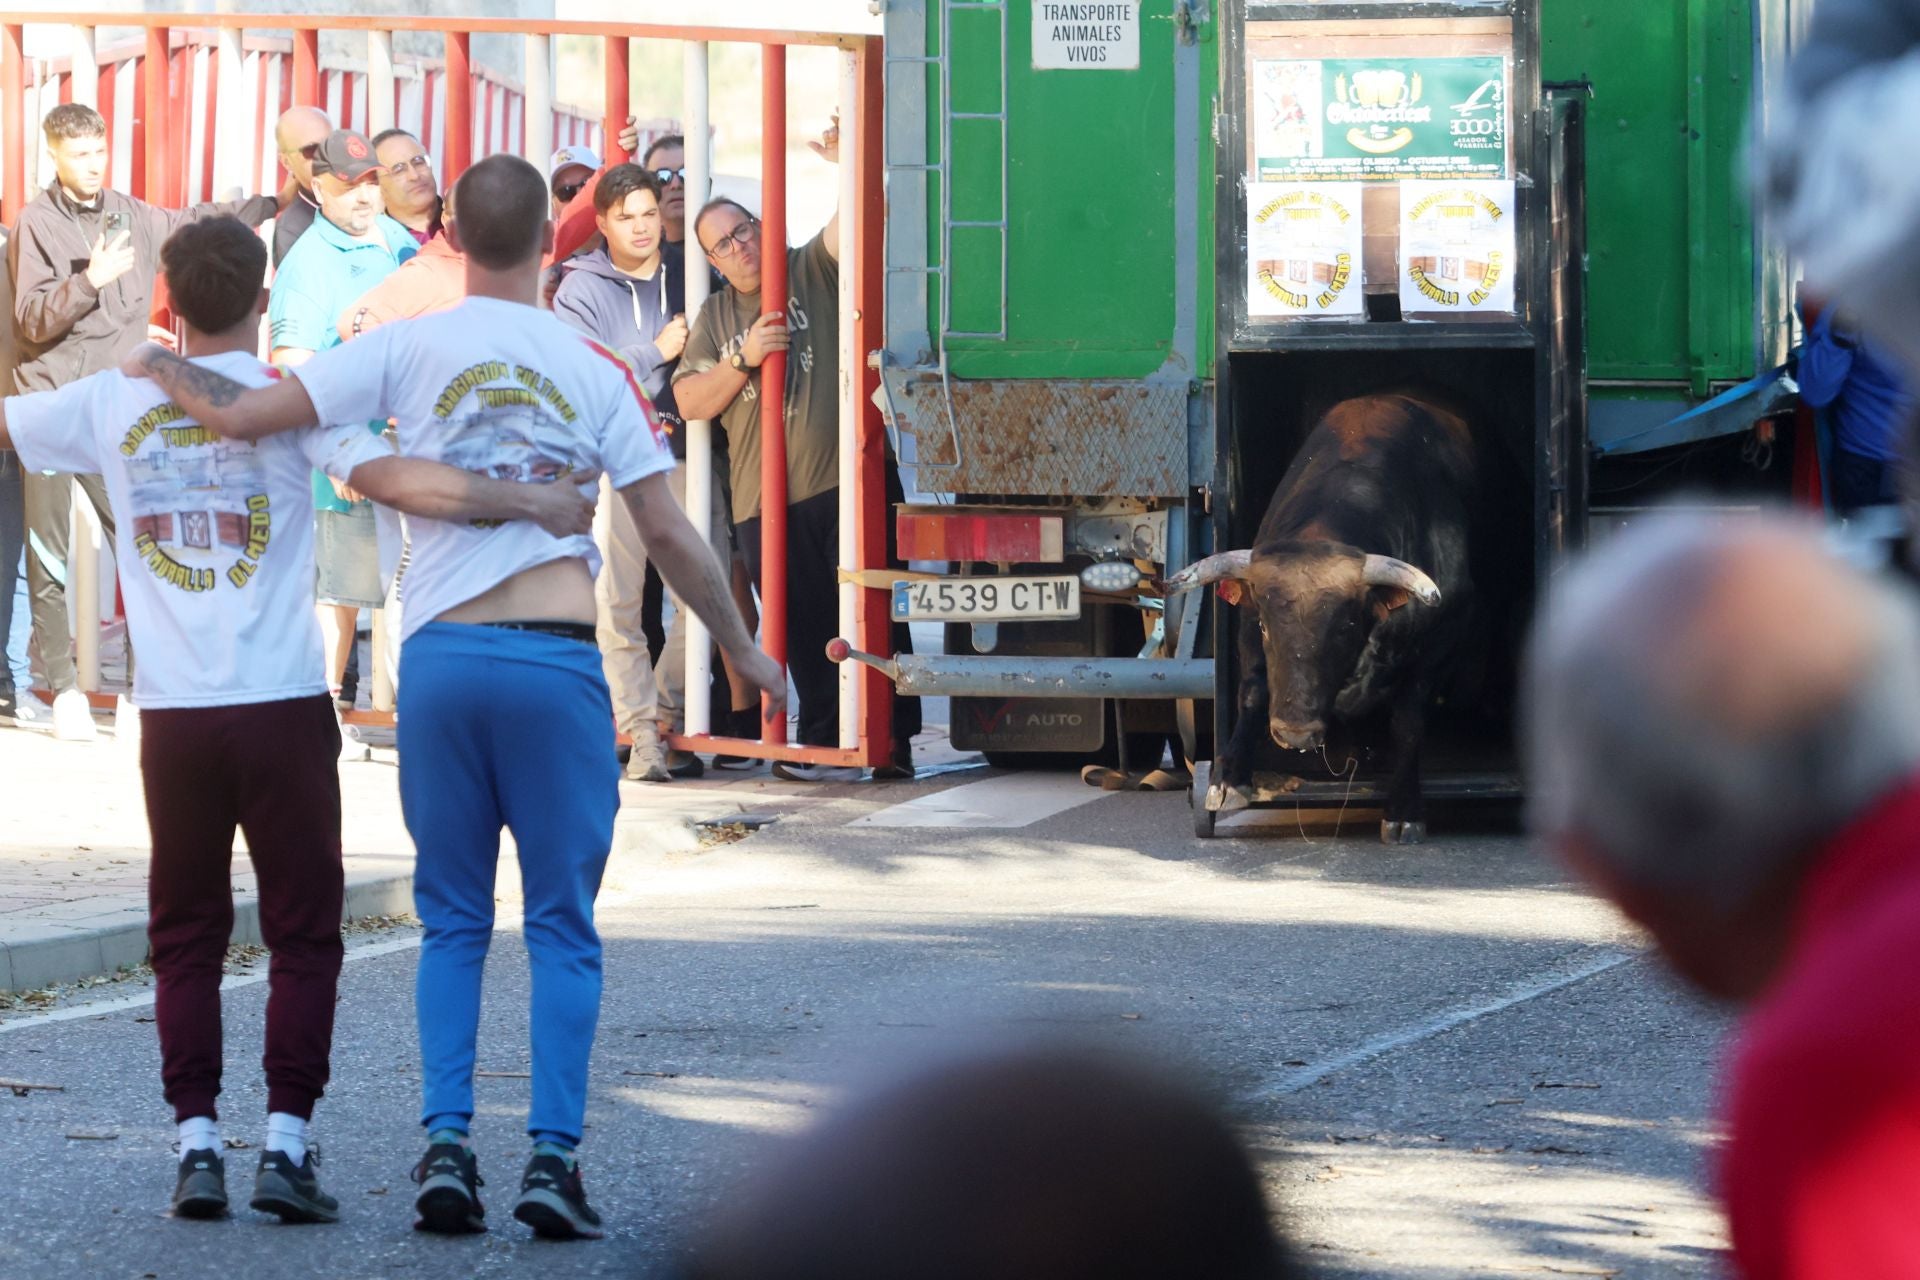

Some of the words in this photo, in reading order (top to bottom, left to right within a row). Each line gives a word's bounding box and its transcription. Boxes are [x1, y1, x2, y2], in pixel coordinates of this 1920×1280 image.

[1042, 4, 1131, 21] TRANSPORTE
[1052, 25, 1121, 41] ANIMALES
[1066, 45, 1107, 62] VIVOS
[1362, 156, 1400, 166] OLMEDO
[1316, 252, 1351, 309] OLMEDO
[1467, 250, 1503, 306] OLMEDO
[475, 387, 540, 411] TAURINA
[513, 364, 577, 424] CULTURAL
[119, 401, 188, 456] ASOCIACI
[134, 532, 157, 557] LA
[147, 553, 215, 592] MURALLA
[226, 493, 270, 588] OLMEDO
[898, 602, 906, 612] E
[916, 582, 999, 613] 4539
[1011, 581, 1071, 611] CTW
[1026, 713, 1082, 727] AUTO
